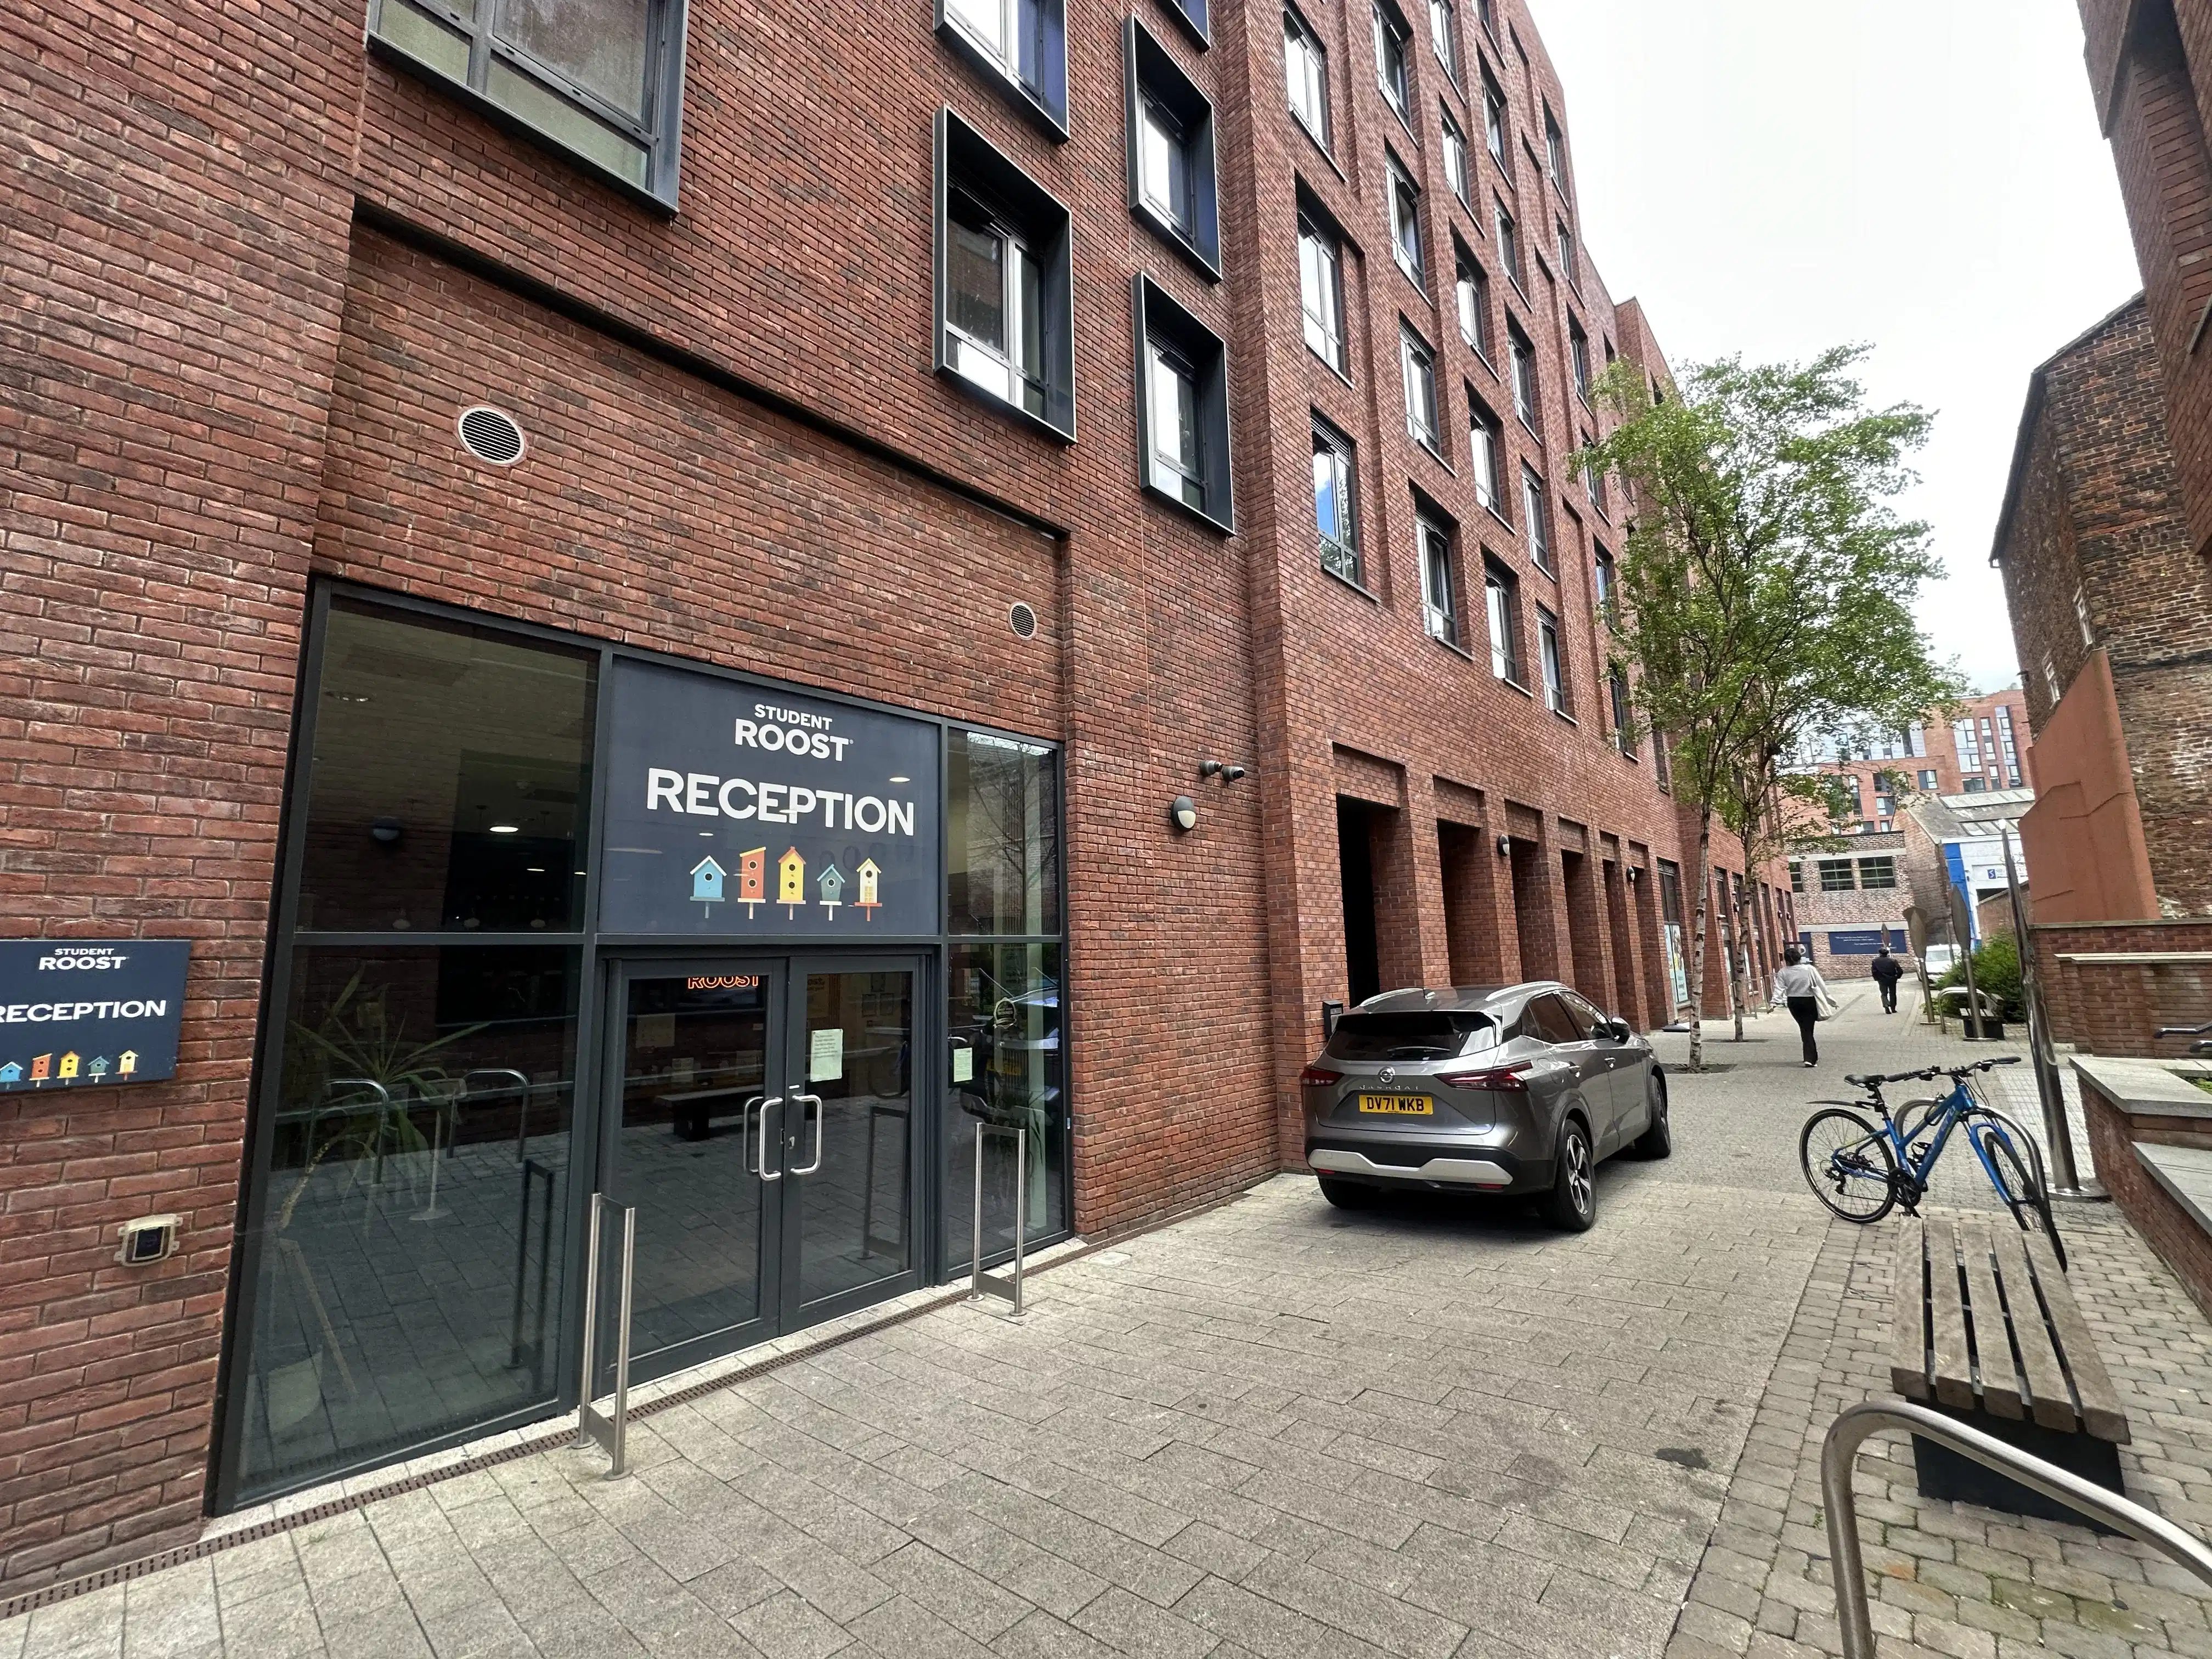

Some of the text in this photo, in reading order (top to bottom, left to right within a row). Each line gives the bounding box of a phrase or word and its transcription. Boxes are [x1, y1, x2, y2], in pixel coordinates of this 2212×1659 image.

[754, 703, 833, 731] STUDENT
[735, 718, 849, 762] ROOST
[646, 768, 915, 837] RECEPTION
[38, 956, 127, 970] ROOST
[1366, 1097, 1424, 1111] DV71 WKB
